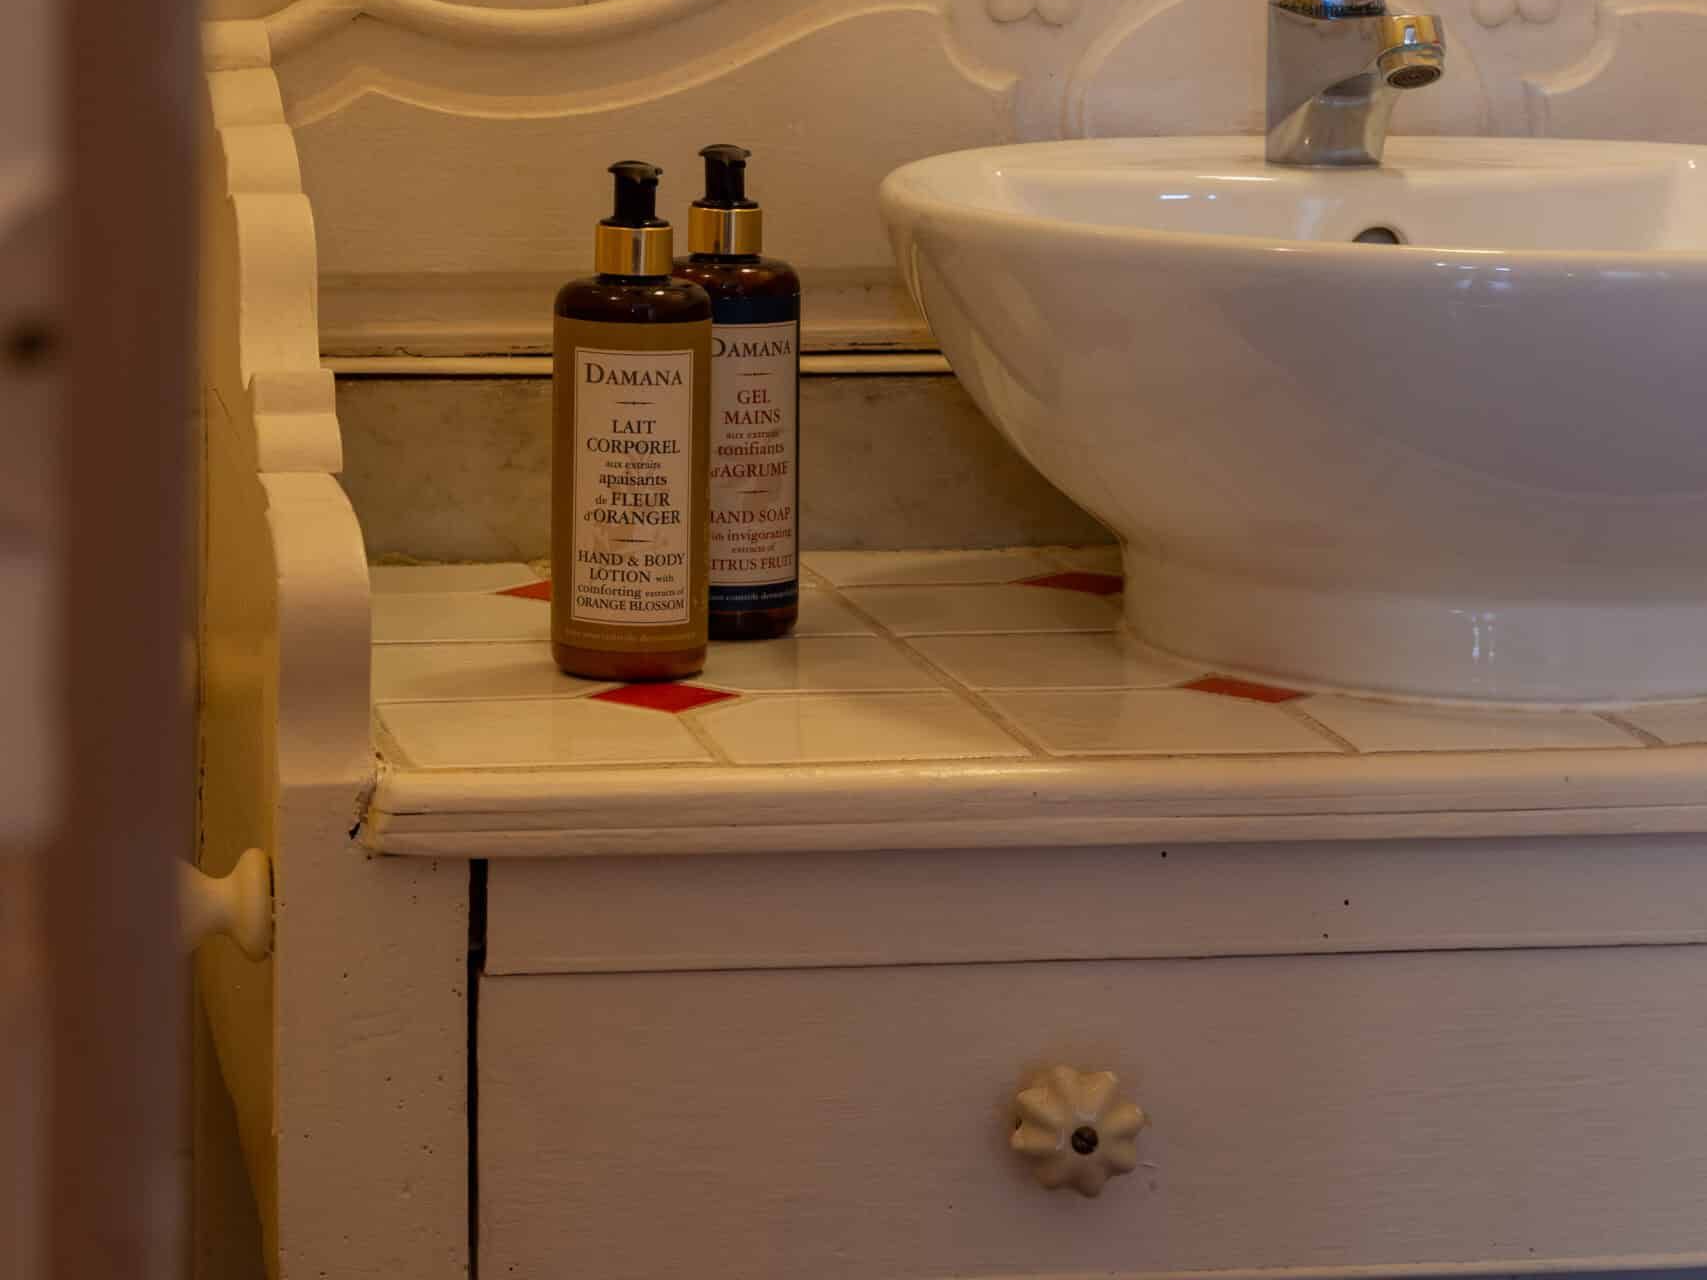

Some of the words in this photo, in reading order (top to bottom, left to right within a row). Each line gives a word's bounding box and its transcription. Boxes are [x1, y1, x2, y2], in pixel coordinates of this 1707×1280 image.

[583, 362, 683, 386] DAMANA
[737, 389, 771, 405] GEL
[724, 408, 782, 424] MAINS
[612, 419, 657, 434] LAIT
[586, 438, 681, 455] CORPOREL
[718, 441, 785, 457] tonifiants
[605, 461, 623, 469] aux
[625, 460, 661, 469] extraits
[599, 471, 668, 488] apaisants
[595, 494, 608, 505] de
[611, 492, 671, 507] FLEUR
[584, 508, 681, 526] d'ORANGER
[759, 506, 792, 523] SOAP
[577, 549, 624, 566] HAND
[627, 556, 639, 567] &
[645, 553, 686, 567] BODY
[711, 558, 757, 571] ITRUS
[590, 567, 650, 583] LOTION
[655, 573, 674, 583] with
[577, 583, 642, 599] comforting
[576, 595, 627, 611] ORANGE
[630, 598, 685, 611] BLOSSOM
